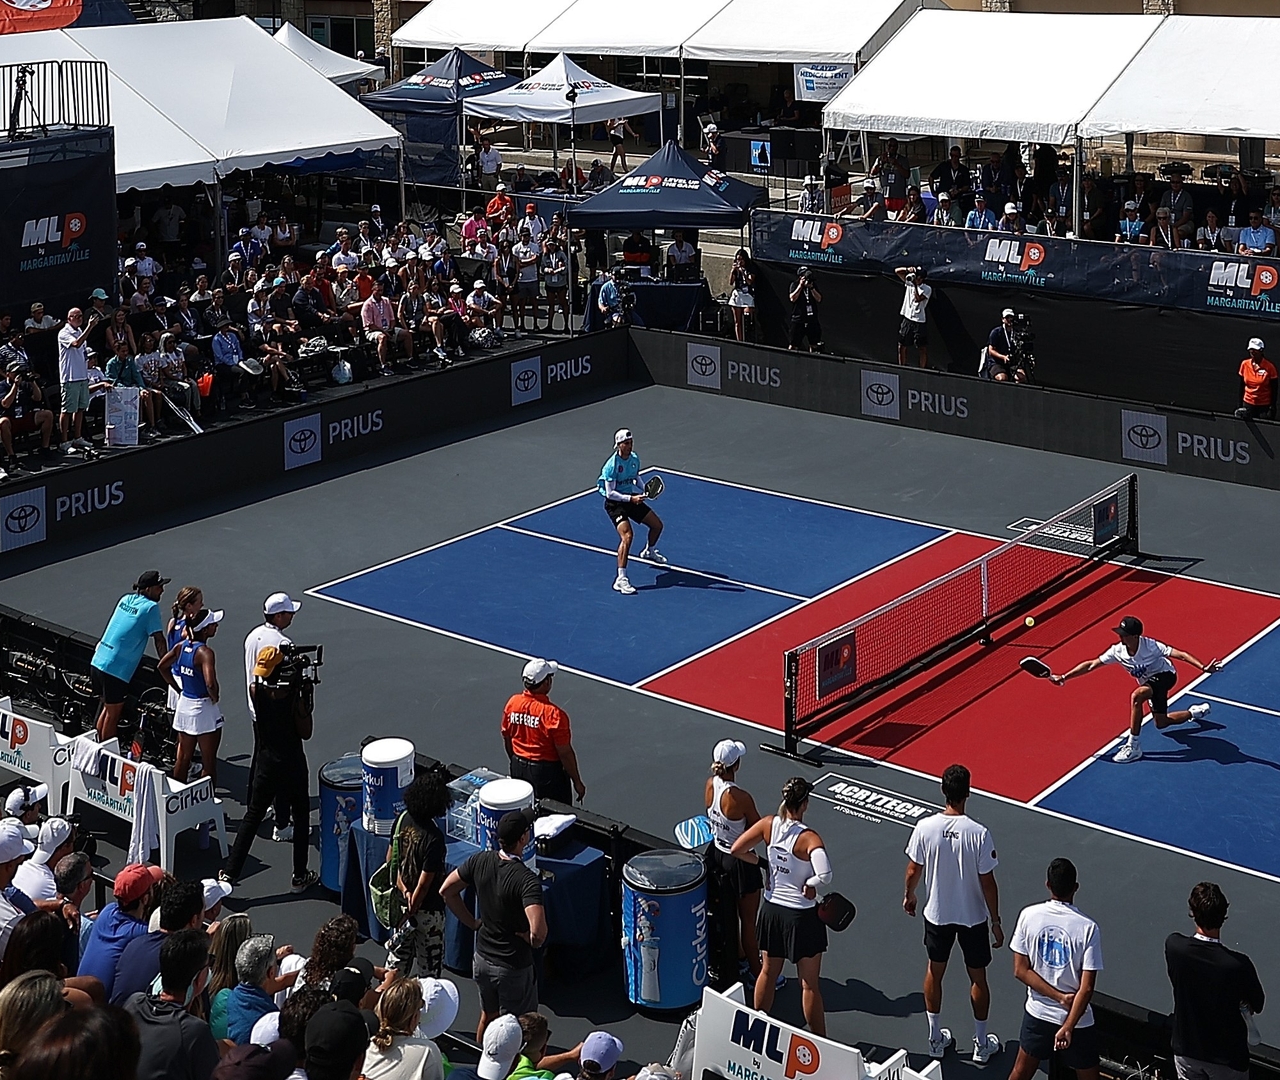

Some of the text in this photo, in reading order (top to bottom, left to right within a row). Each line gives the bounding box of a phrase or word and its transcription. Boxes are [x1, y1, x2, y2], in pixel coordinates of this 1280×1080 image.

[622, 176, 662, 188] MLP
[21, 212, 87, 248] MLP
[791, 219, 843, 249] MLP
[20, 243, 90, 272] MARGARITAVILLE
[788, 247, 843, 264] MARGARITAVILLE
[985, 238, 1046, 271] MLP
[981, 268, 1046, 287] MARGARITAVILLE
[1209, 261, 1279, 296] MLP
[1206, 293, 1280, 313] MARGARITAVILLE
[546, 354, 592, 384] PRIUS
[727, 360, 781, 388] PRIUS
[907, 388, 969, 419] PRIUS
[329, 409, 384, 445] PRIUS
[1176, 430, 1251, 465] PRIUS
[55, 478, 124, 522] PRIUS
[509, 711, 540, 728] REFEREE
[361, 769, 384, 787] Cirkul
[166, 783, 215, 815] Cirkul
[827, 781, 927, 818] ACRYTECH
[834, 794, 906, 819] SPORTS SURFACES
[833, 805, 882, 824] ATSports.com
[690, 899, 707, 986] Cirkul
[730, 1009, 821, 1080] MLP
[752, 1057, 761, 1069] by
